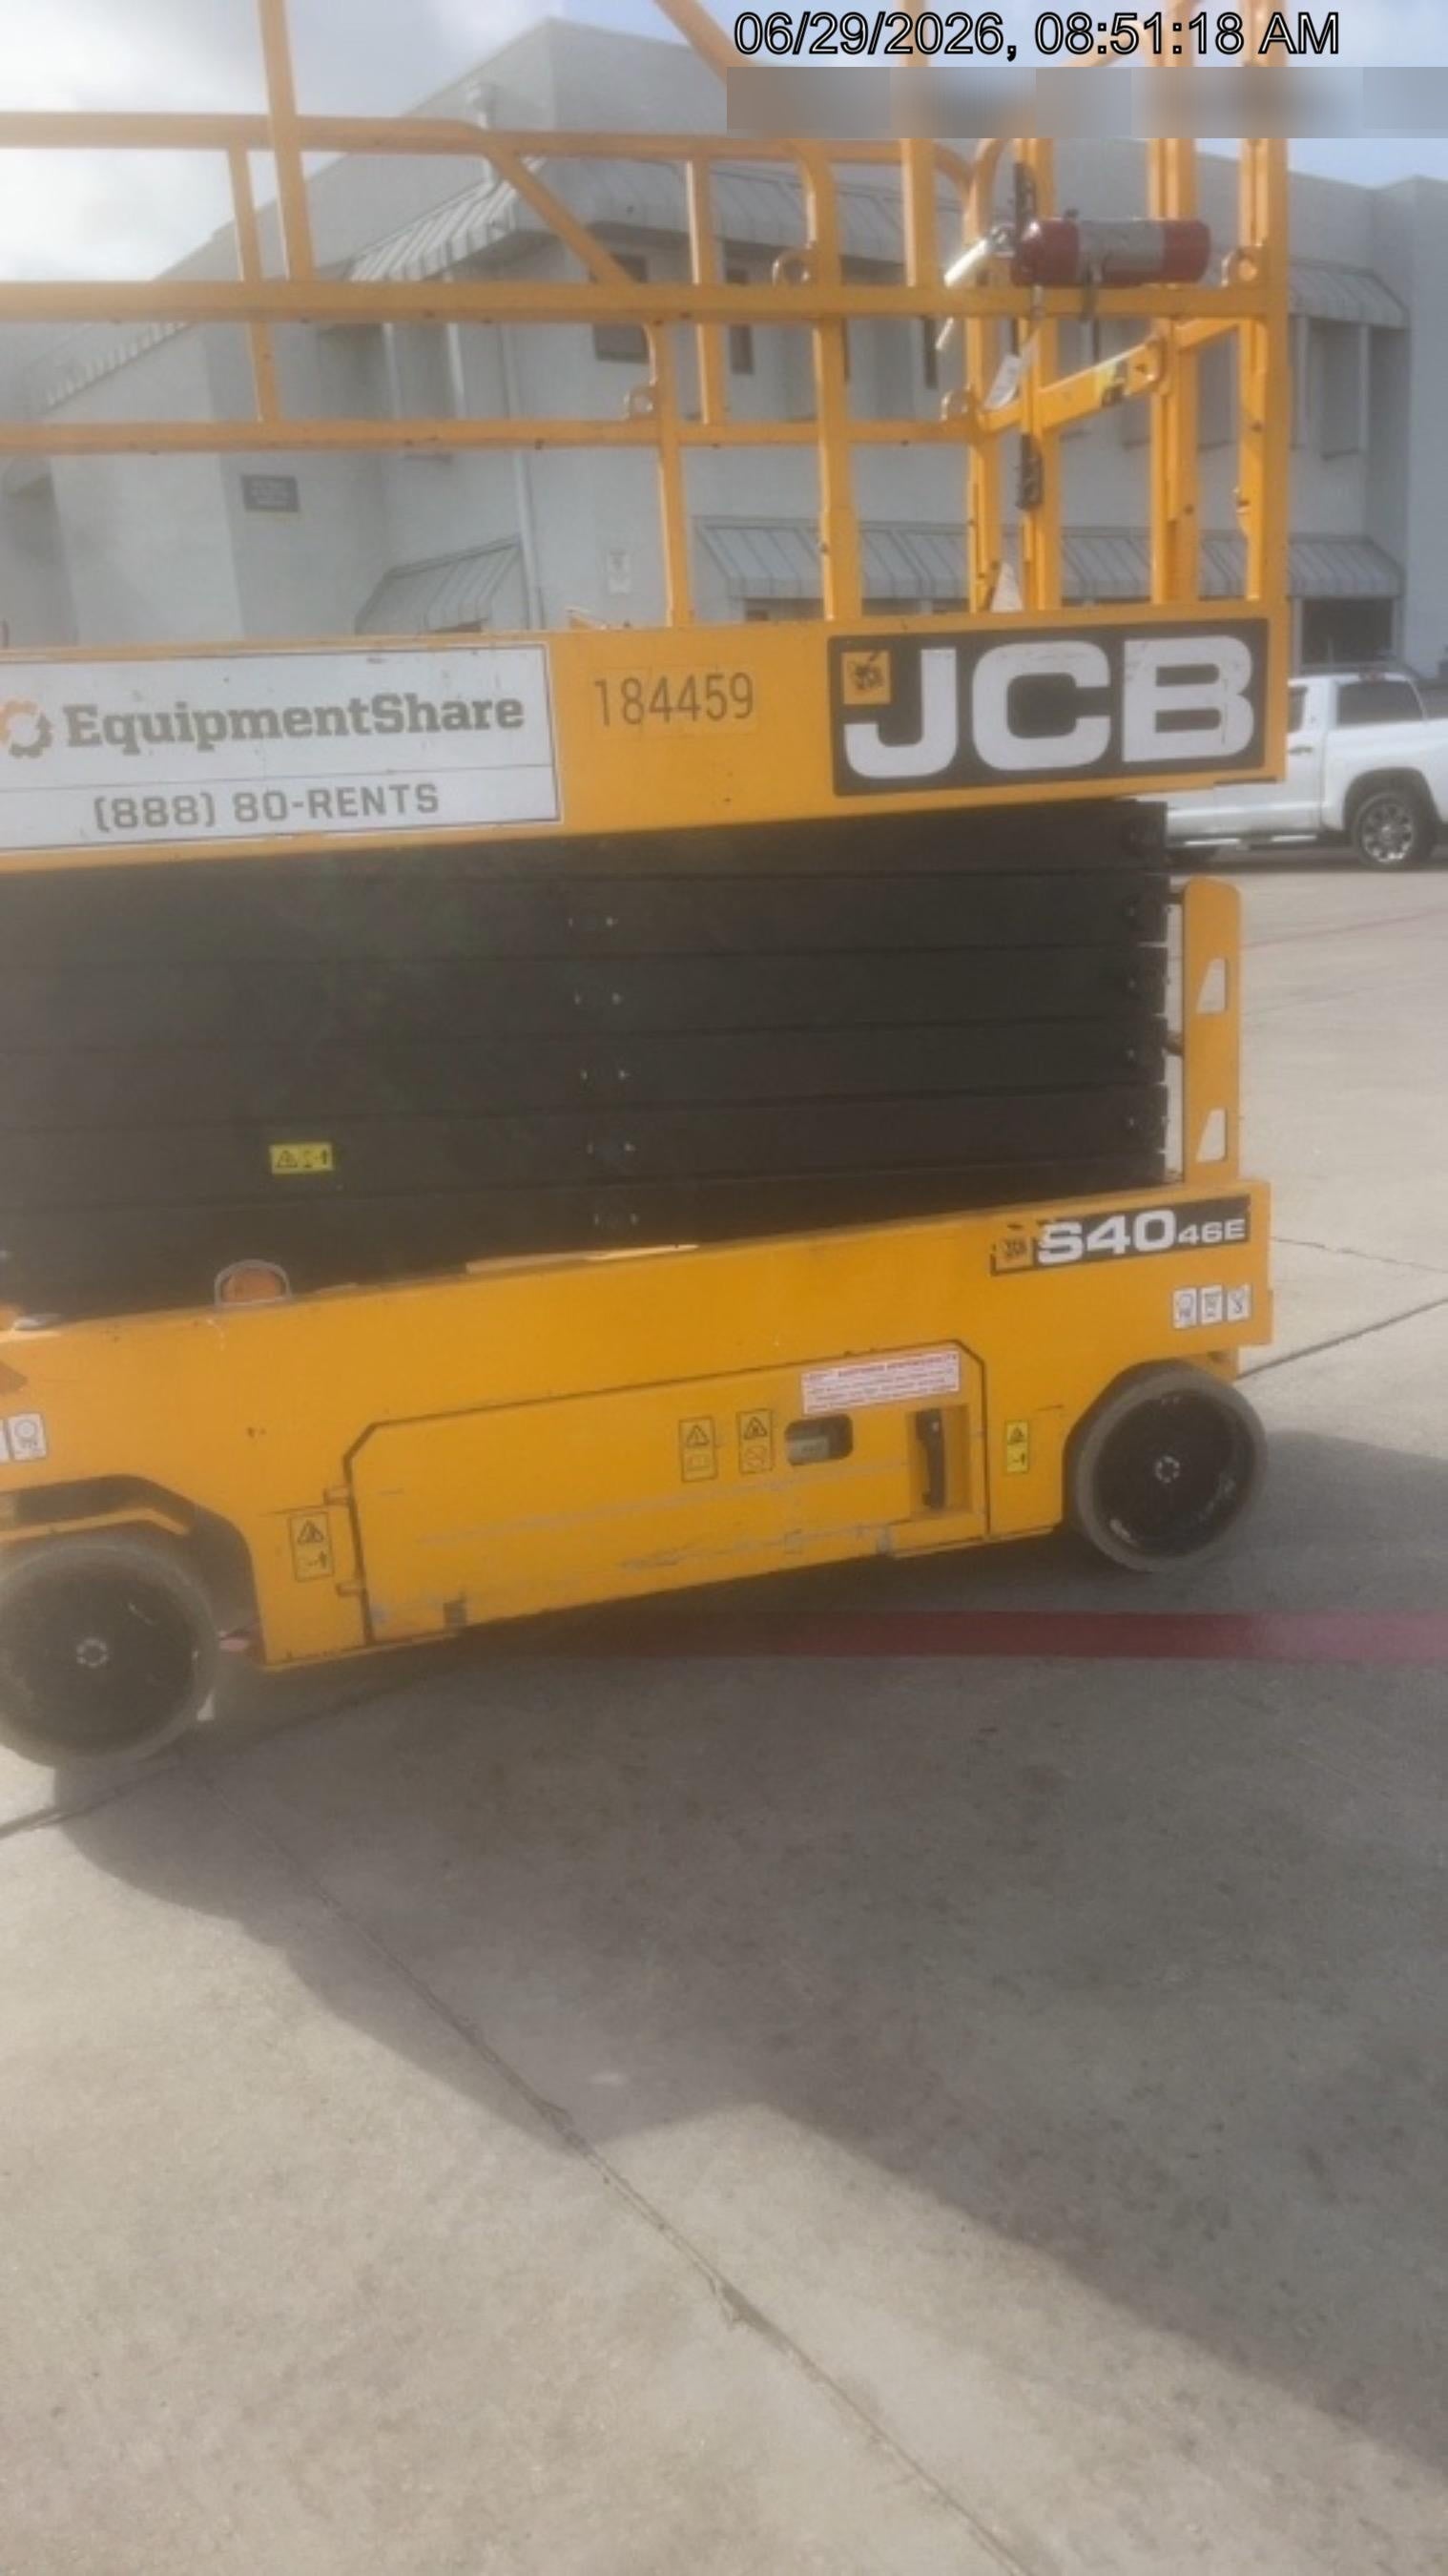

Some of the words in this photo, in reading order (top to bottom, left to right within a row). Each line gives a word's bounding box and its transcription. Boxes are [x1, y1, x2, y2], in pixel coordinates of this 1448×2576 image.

[63, 692, 525, 755] EquipmentShare
[592, 672, 755, 727] 184459
[844, 635, 1255, 779] JCB
[93, 792, 216, 833] (888)
[232, 782, 440, 823] 80-RENTS
[1038, 1209, 1177, 1266] S40
[1178, 1218, 1246, 1245] 46E
